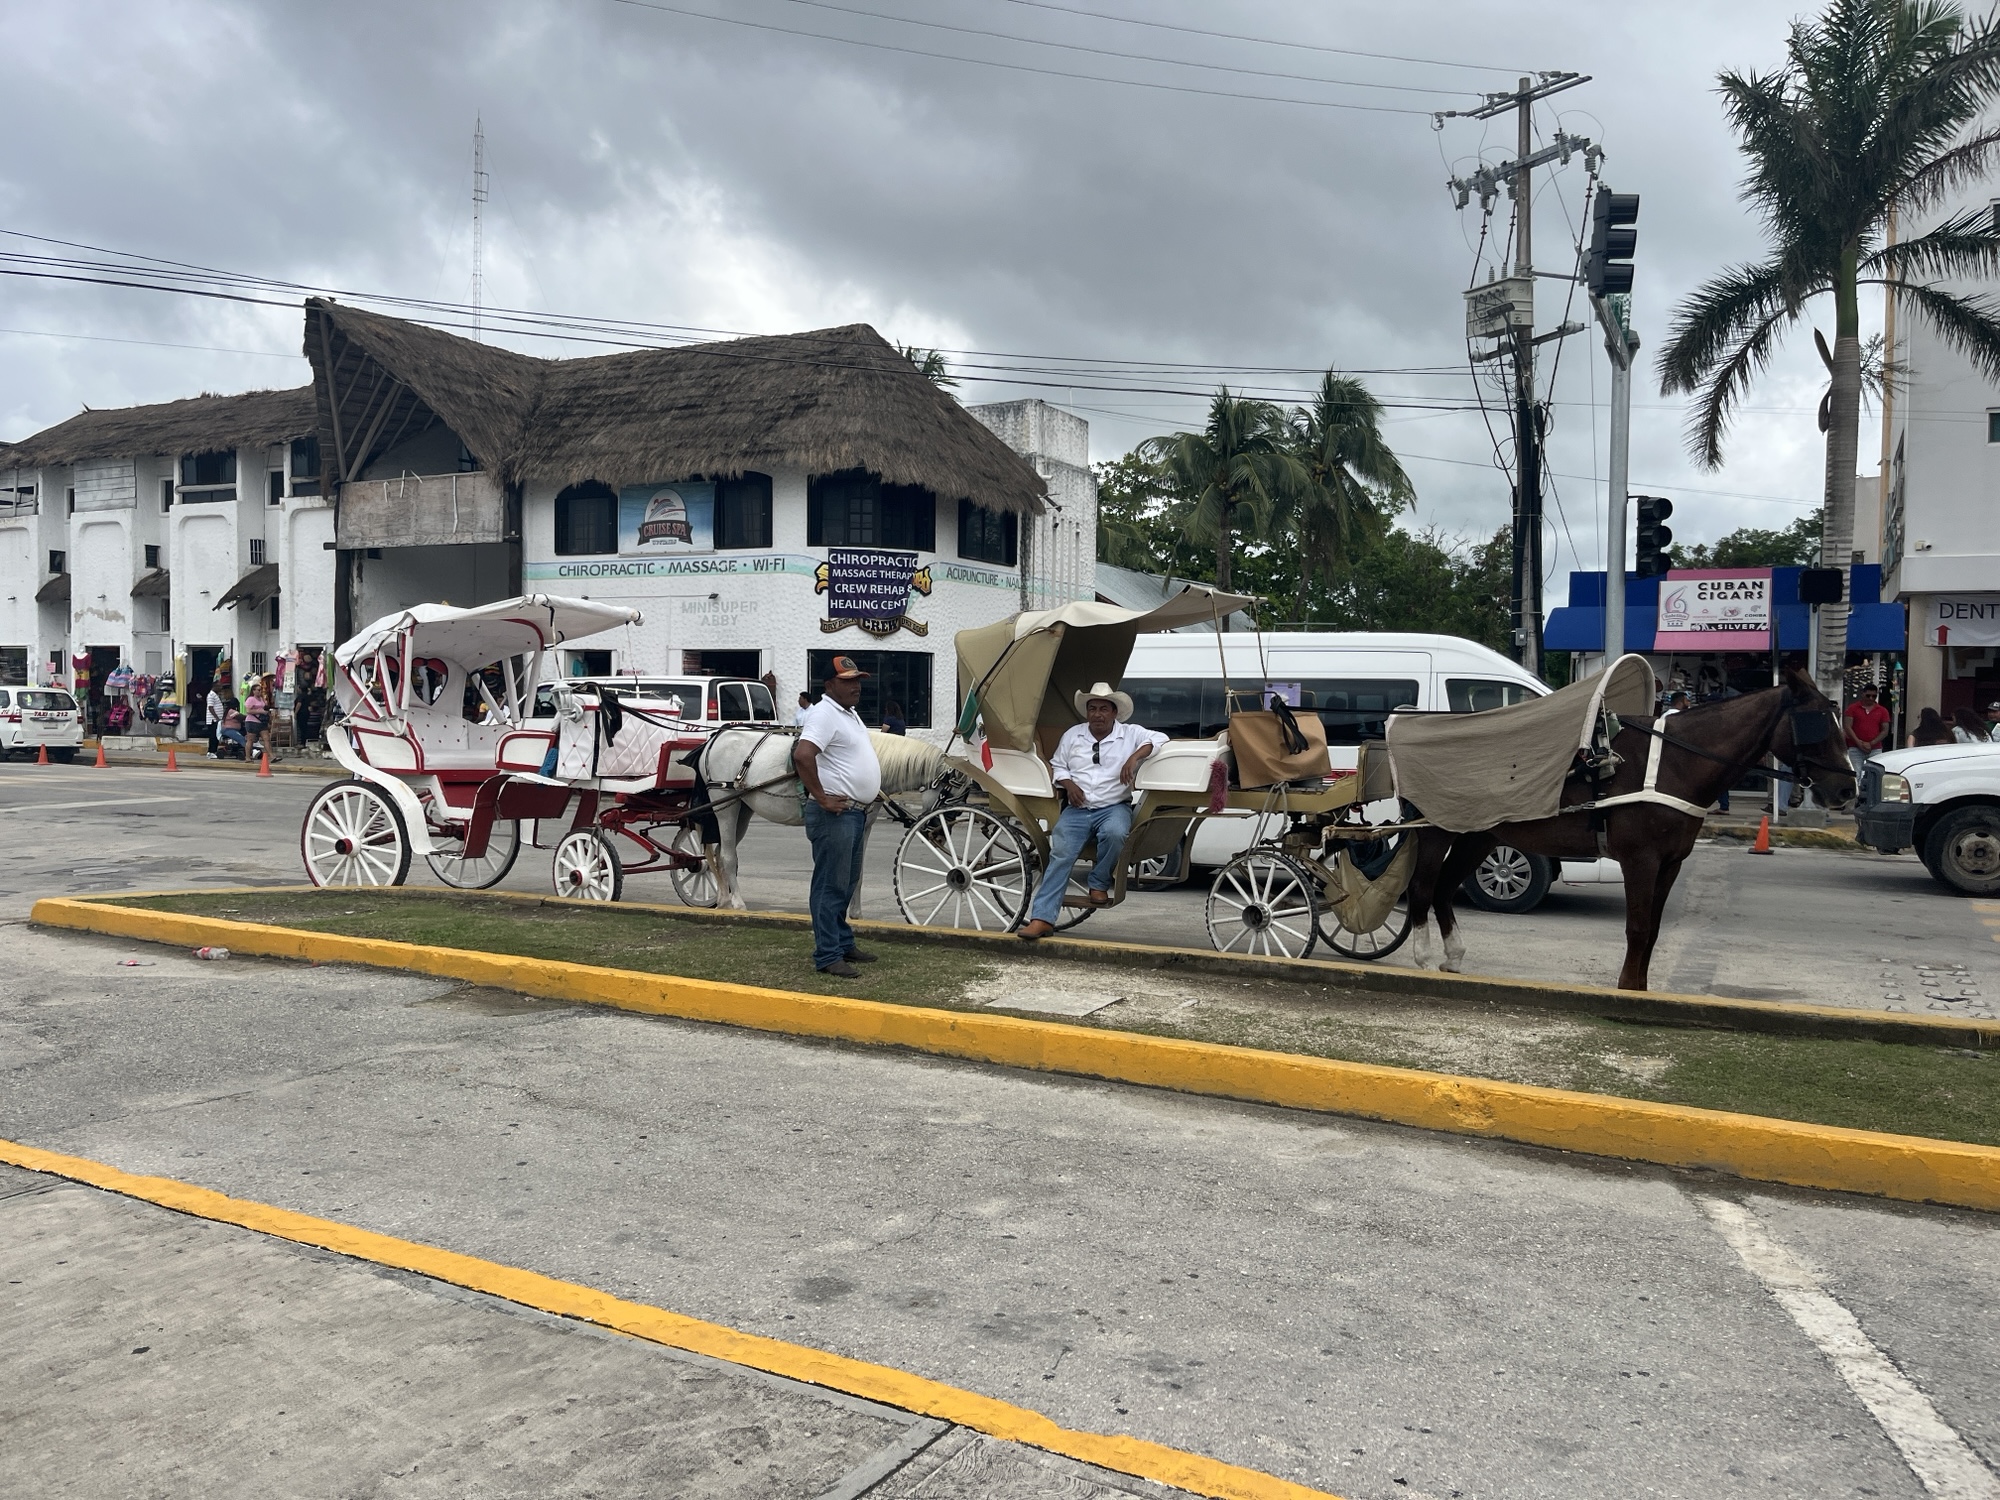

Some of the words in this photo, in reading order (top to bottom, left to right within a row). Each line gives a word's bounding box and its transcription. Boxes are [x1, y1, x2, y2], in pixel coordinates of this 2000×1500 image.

[644, 522, 671, 537] CRUISE
[671, 523, 687, 537] SPA
[559, 562, 656, 577] CHIROPRACTIC
[668, 560, 738, 574] MASSAGE
[753, 557, 786, 572] WI-FI
[832, 568, 877, 578] MASSAGE
[946, 566, 999, 586] ACUPUNCTURE
[834, 583, 867, 594] CREW
[869, 584, 906, 595] REHAB
[1697, 581, 1765, 591] CUBAN
[1697, 590, 1765, 601] CIGARS
[680, 600, 759, 614] MINISUPER
[830, 599, 879, 610] HEALING
[1940, 602, 2000, 619] DENT
[700, 614, 739, 626] ABBY
[862, 618, 899, 632] CREW
